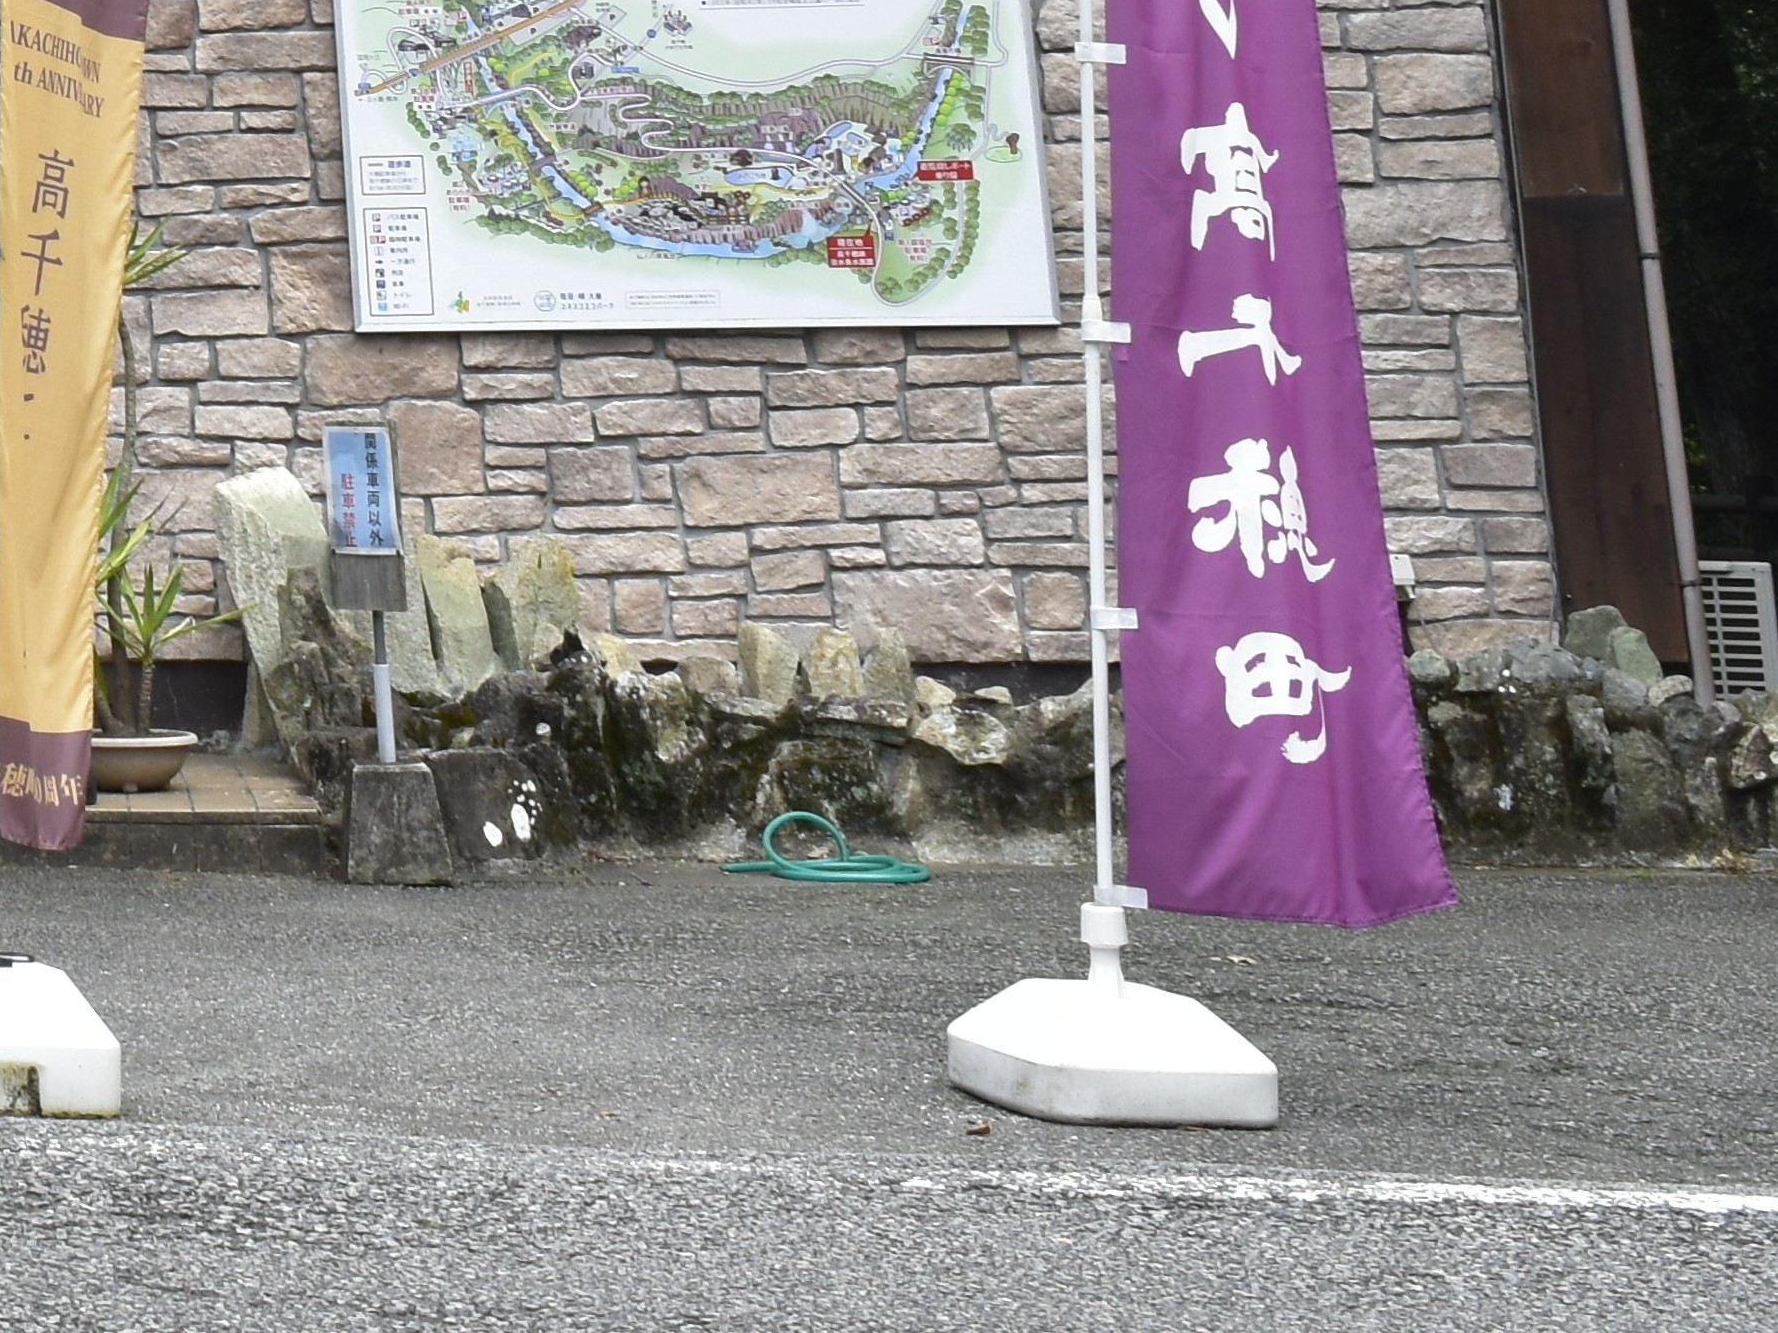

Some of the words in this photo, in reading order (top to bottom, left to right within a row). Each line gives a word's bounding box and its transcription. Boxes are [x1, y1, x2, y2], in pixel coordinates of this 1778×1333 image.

[341, 473, 357, 548] 駐車禁止
[365, 433, 384, 547] 関係車両以外
